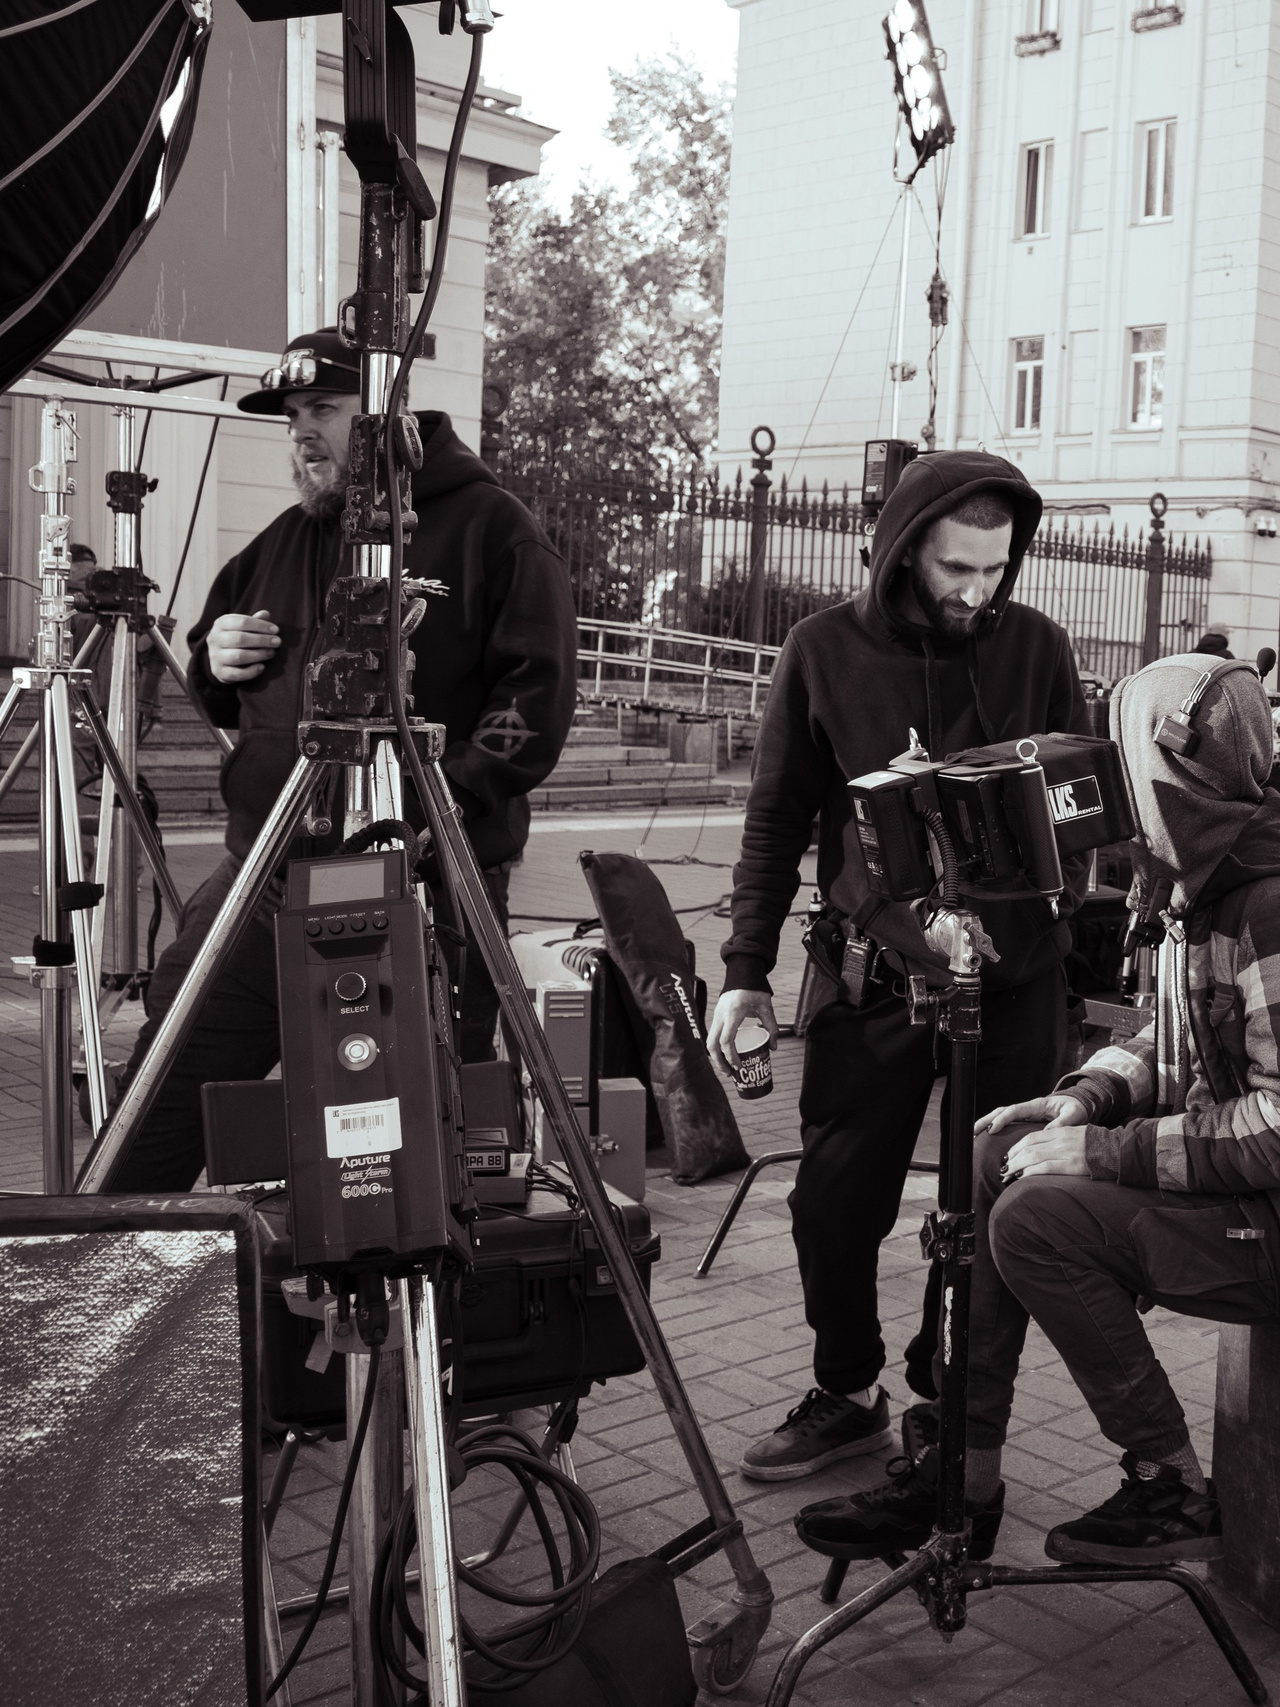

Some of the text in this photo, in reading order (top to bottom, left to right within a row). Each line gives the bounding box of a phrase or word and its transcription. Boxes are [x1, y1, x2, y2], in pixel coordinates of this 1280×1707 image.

[1047, 784, 1102, 821] LKS RENTAL
[340, 1005, 370, 1014] SELECT
[741, 1056, 760, 1067] ccino
[487, 1155, 502, 1166] 88
[381, 1186, 393, 1194] Pro
